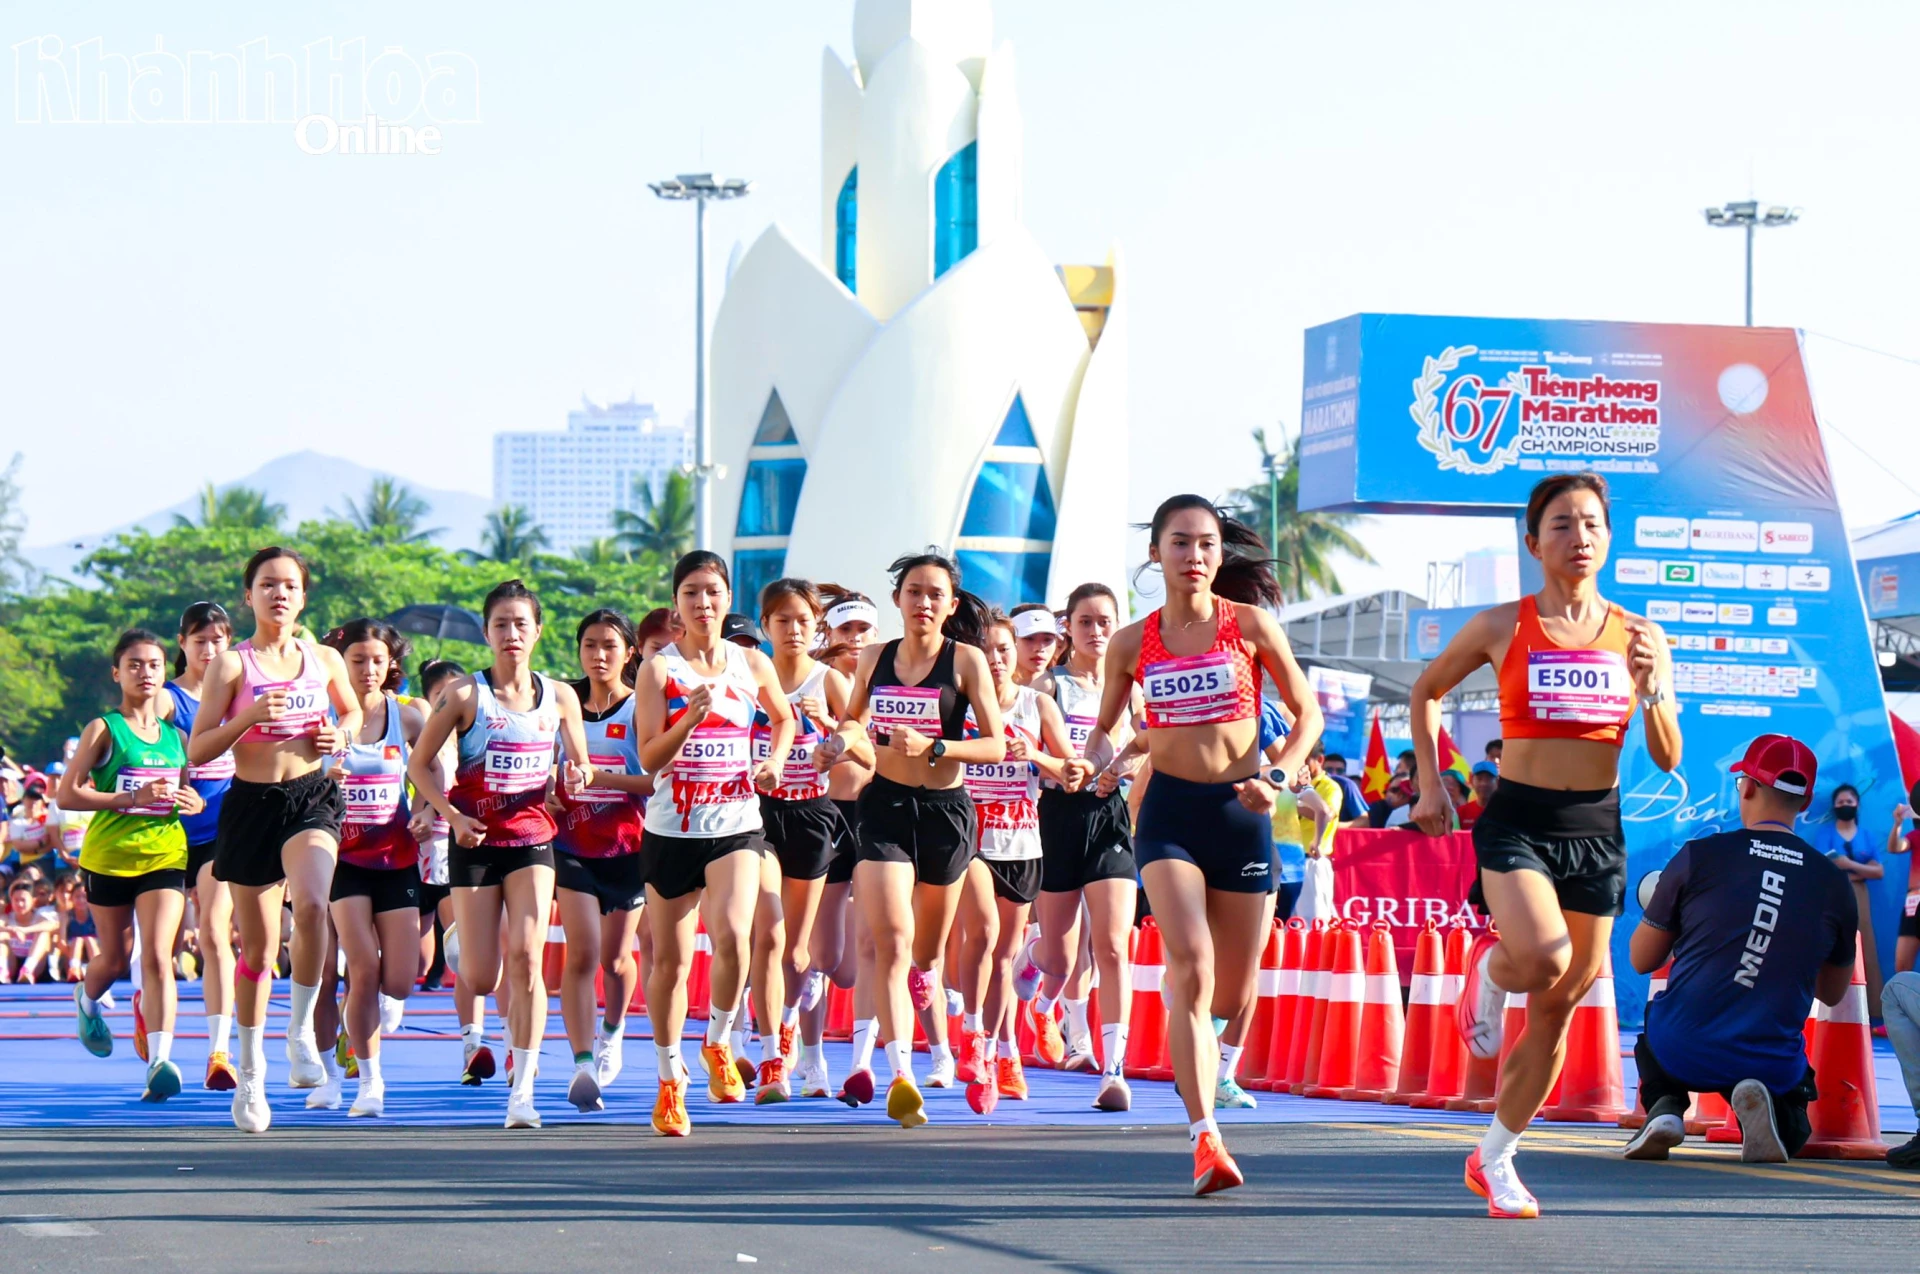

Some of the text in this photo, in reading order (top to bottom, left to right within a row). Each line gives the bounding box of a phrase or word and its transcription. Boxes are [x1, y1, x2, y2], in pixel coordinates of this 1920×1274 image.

[1445, 377, 1512, 449] 67
[1522, 400, 1657, 424] Marathon
[1521, 425, 1610, 438] NATIONAL
[1521, 439, 1657, 453] CHAMPIONSHIP
[1703, 530, 1756, 541] AGRIBANK
[1778, 533, 1809, 542] SABECO
[1150, 671, 1220, 698] E5025
[1538, 668, 1610, 690] E5001
[875, 699, 927, 715] E5027
[682, 742, 735, 758] E5021
[758, 743, 807, 760] E20
[491, 755, 541, 770] E5012
[965, 764, 1016, 778] E5019
[341, 788, 388, 802] E5014
[1749, 847, 1803, 866] Marathon
[1331, 896, 1490, 929] GRIBA
[1733, 869, 1787, 989] MEDIA
